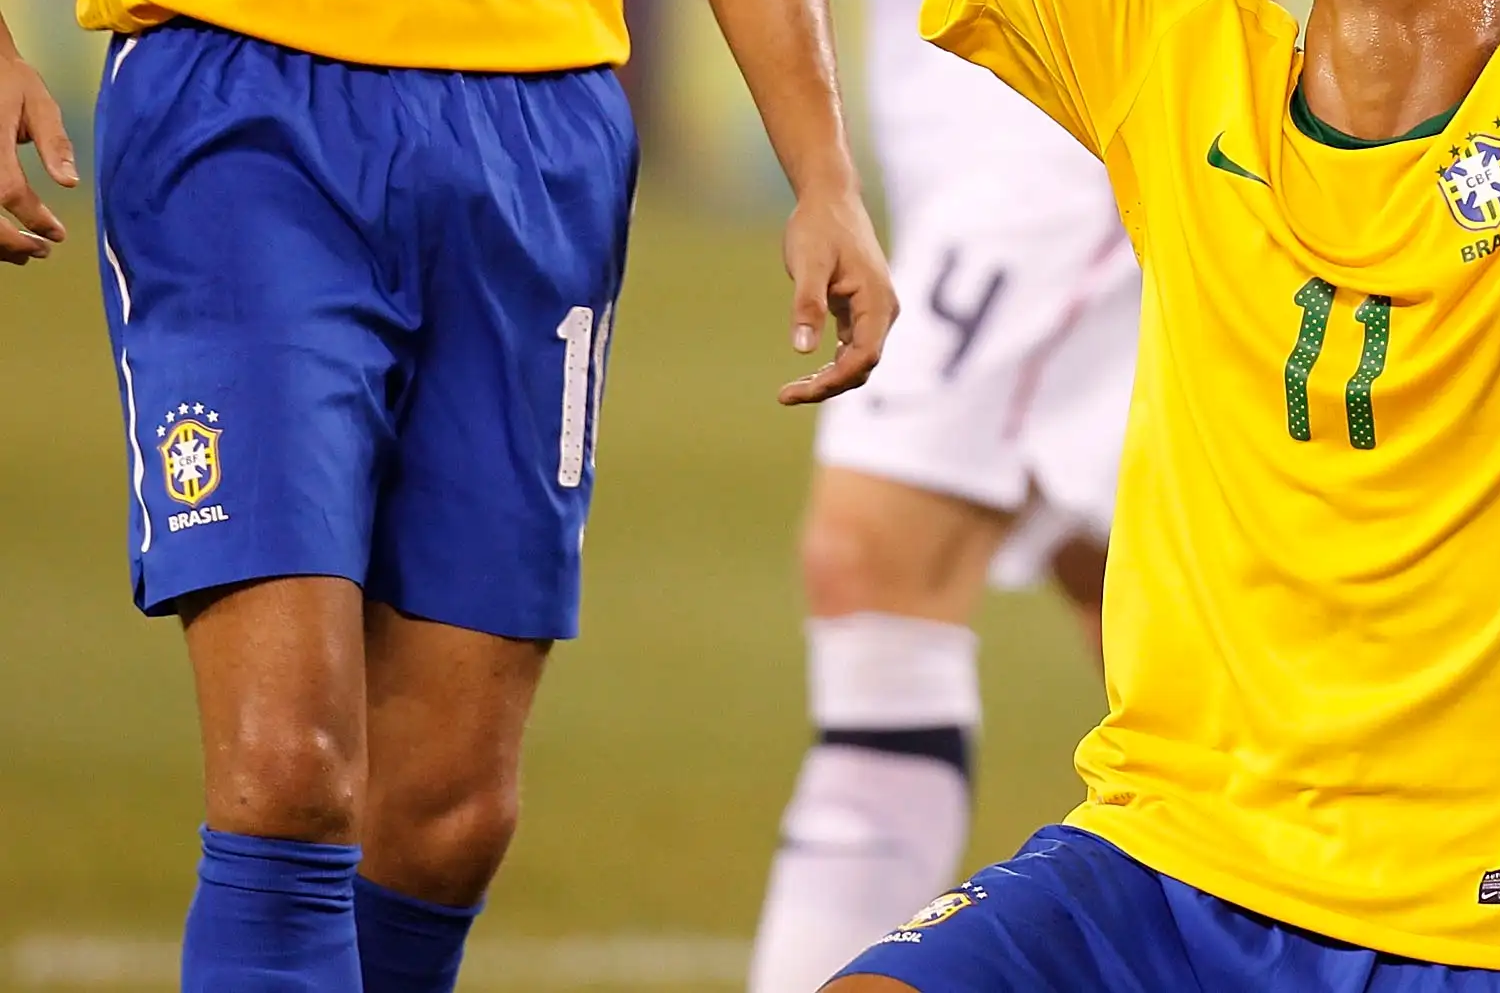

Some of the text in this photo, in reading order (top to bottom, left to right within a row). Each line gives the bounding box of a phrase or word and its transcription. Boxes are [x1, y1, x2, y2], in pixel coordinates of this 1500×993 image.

[1465, 169, 1493, 189] CBF
[927, 246, 1008, 381] 4
[1285, 277, 1391, 450] 11
[179, 454, 199, 467] CBF
[168, 505, 229, 532] BRASIL
